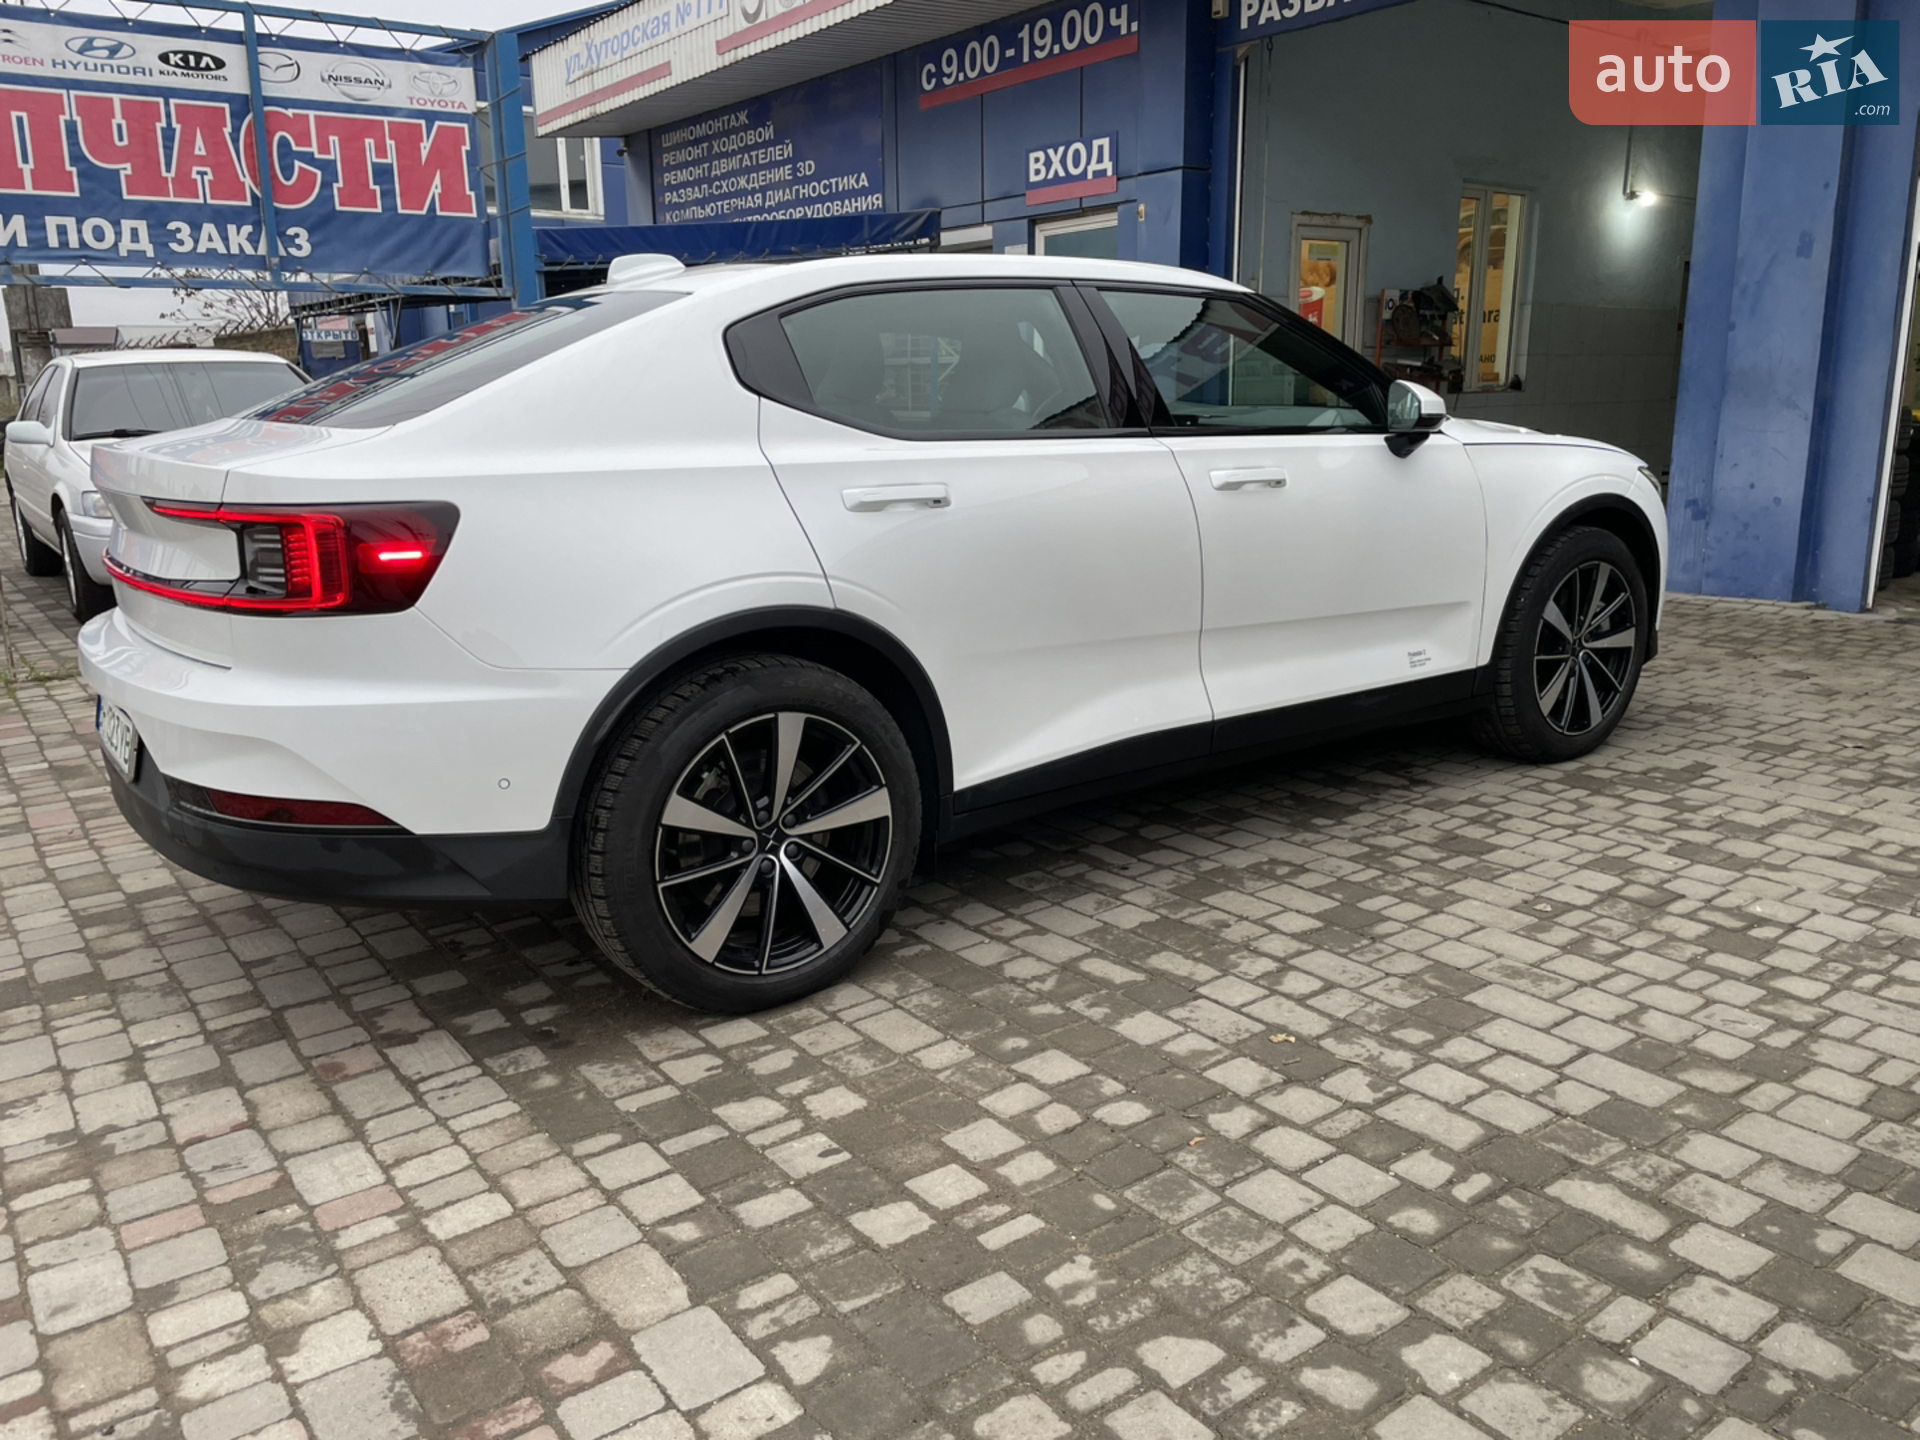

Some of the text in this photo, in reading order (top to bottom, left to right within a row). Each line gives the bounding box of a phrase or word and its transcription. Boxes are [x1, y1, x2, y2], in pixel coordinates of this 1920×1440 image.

[0, 54, 45, 67] ROEN
[51, 58, 154, 77] HYUNDAI
[167, 52, 216, 69] KIA
[158, 69, 229, 82] KIA MOTORS
[327, 73, 386, 87] NISSAN
[407, 96, 468, 110] TOYOTA
[661, 109, 749, 148] ШИНОМОНТАЖ
[662, 121, 775, 167] РЕМОНТ ХОДОВОЙ
[663, 140, 793, 187] РЕМОНТ ДВИГАТЕЛЕЙ
[1029, 137, 1113, 182] ВХОД
[664, 160, 816, 205] РАЗВАЛ-СХОЖДЕНИЕ 3D
[665, 172, 869, 223] КОМПЬЮТЕРНАЯ ДИАГНОСТИКА
[45, 215, 155, 258] ПОД
[302, 330, 358, 340] ОТКРЫТО
